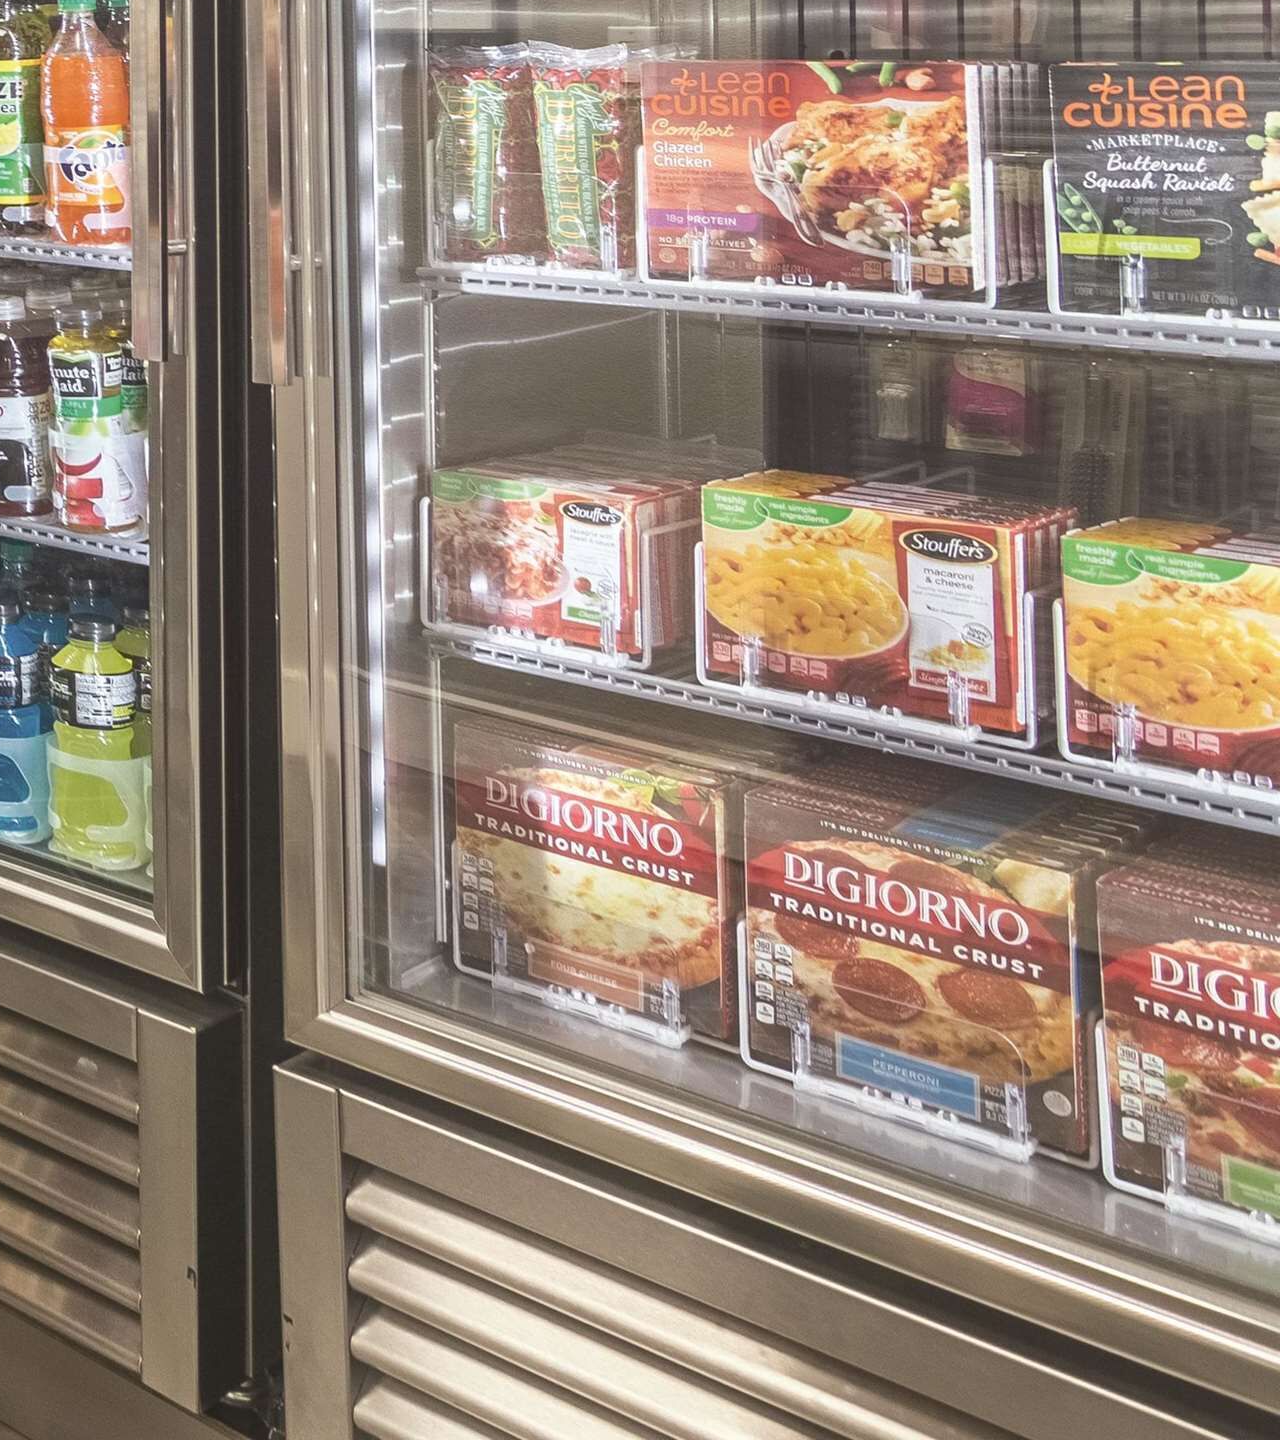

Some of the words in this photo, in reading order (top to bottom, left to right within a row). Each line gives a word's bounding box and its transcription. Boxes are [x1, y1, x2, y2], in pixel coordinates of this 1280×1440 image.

[700, 71, 790, 95] Lean
[1127, 74, 1245, 102] Lean
[652, 120, 735, 138] Comfort
[653, 141, 704, 154] Glazed
[1091, 134, 1218, 153] MARKETPLACE
[654, 155, 712, 169] Chicken
[1106, 153, 1208, 173] Butternut
[1082, 171, 1158, 192] Squash
[1163, 173, 1234, 192] Ravioli
[687, 215, 737, 226] PROTEIN
[567, 503, 618, 524] Stouffer's
[912, 534, 985, 560] Stouffer's
[1075, 543, 1118, 558] freshly
[1079, 553, 1115, 567] made
[923, 566, 975, 582] macaroni
[1158, 565, 1221, 581] ingredients
[936, 576, 973, 591] cheese
[485, 776, 683, 857] DIGIORNO
[474, 813, 613, 865] TRADITIONAL
[622, 856, 695, 885] CRUST
[783, 852, 1028, 947] DIGIORNO
[769, 892, 942, 954] TRADITIONAL
[953, 945, 1044, 979] CRUST
[872, 1058, 940, 1088] PEPPERONI
